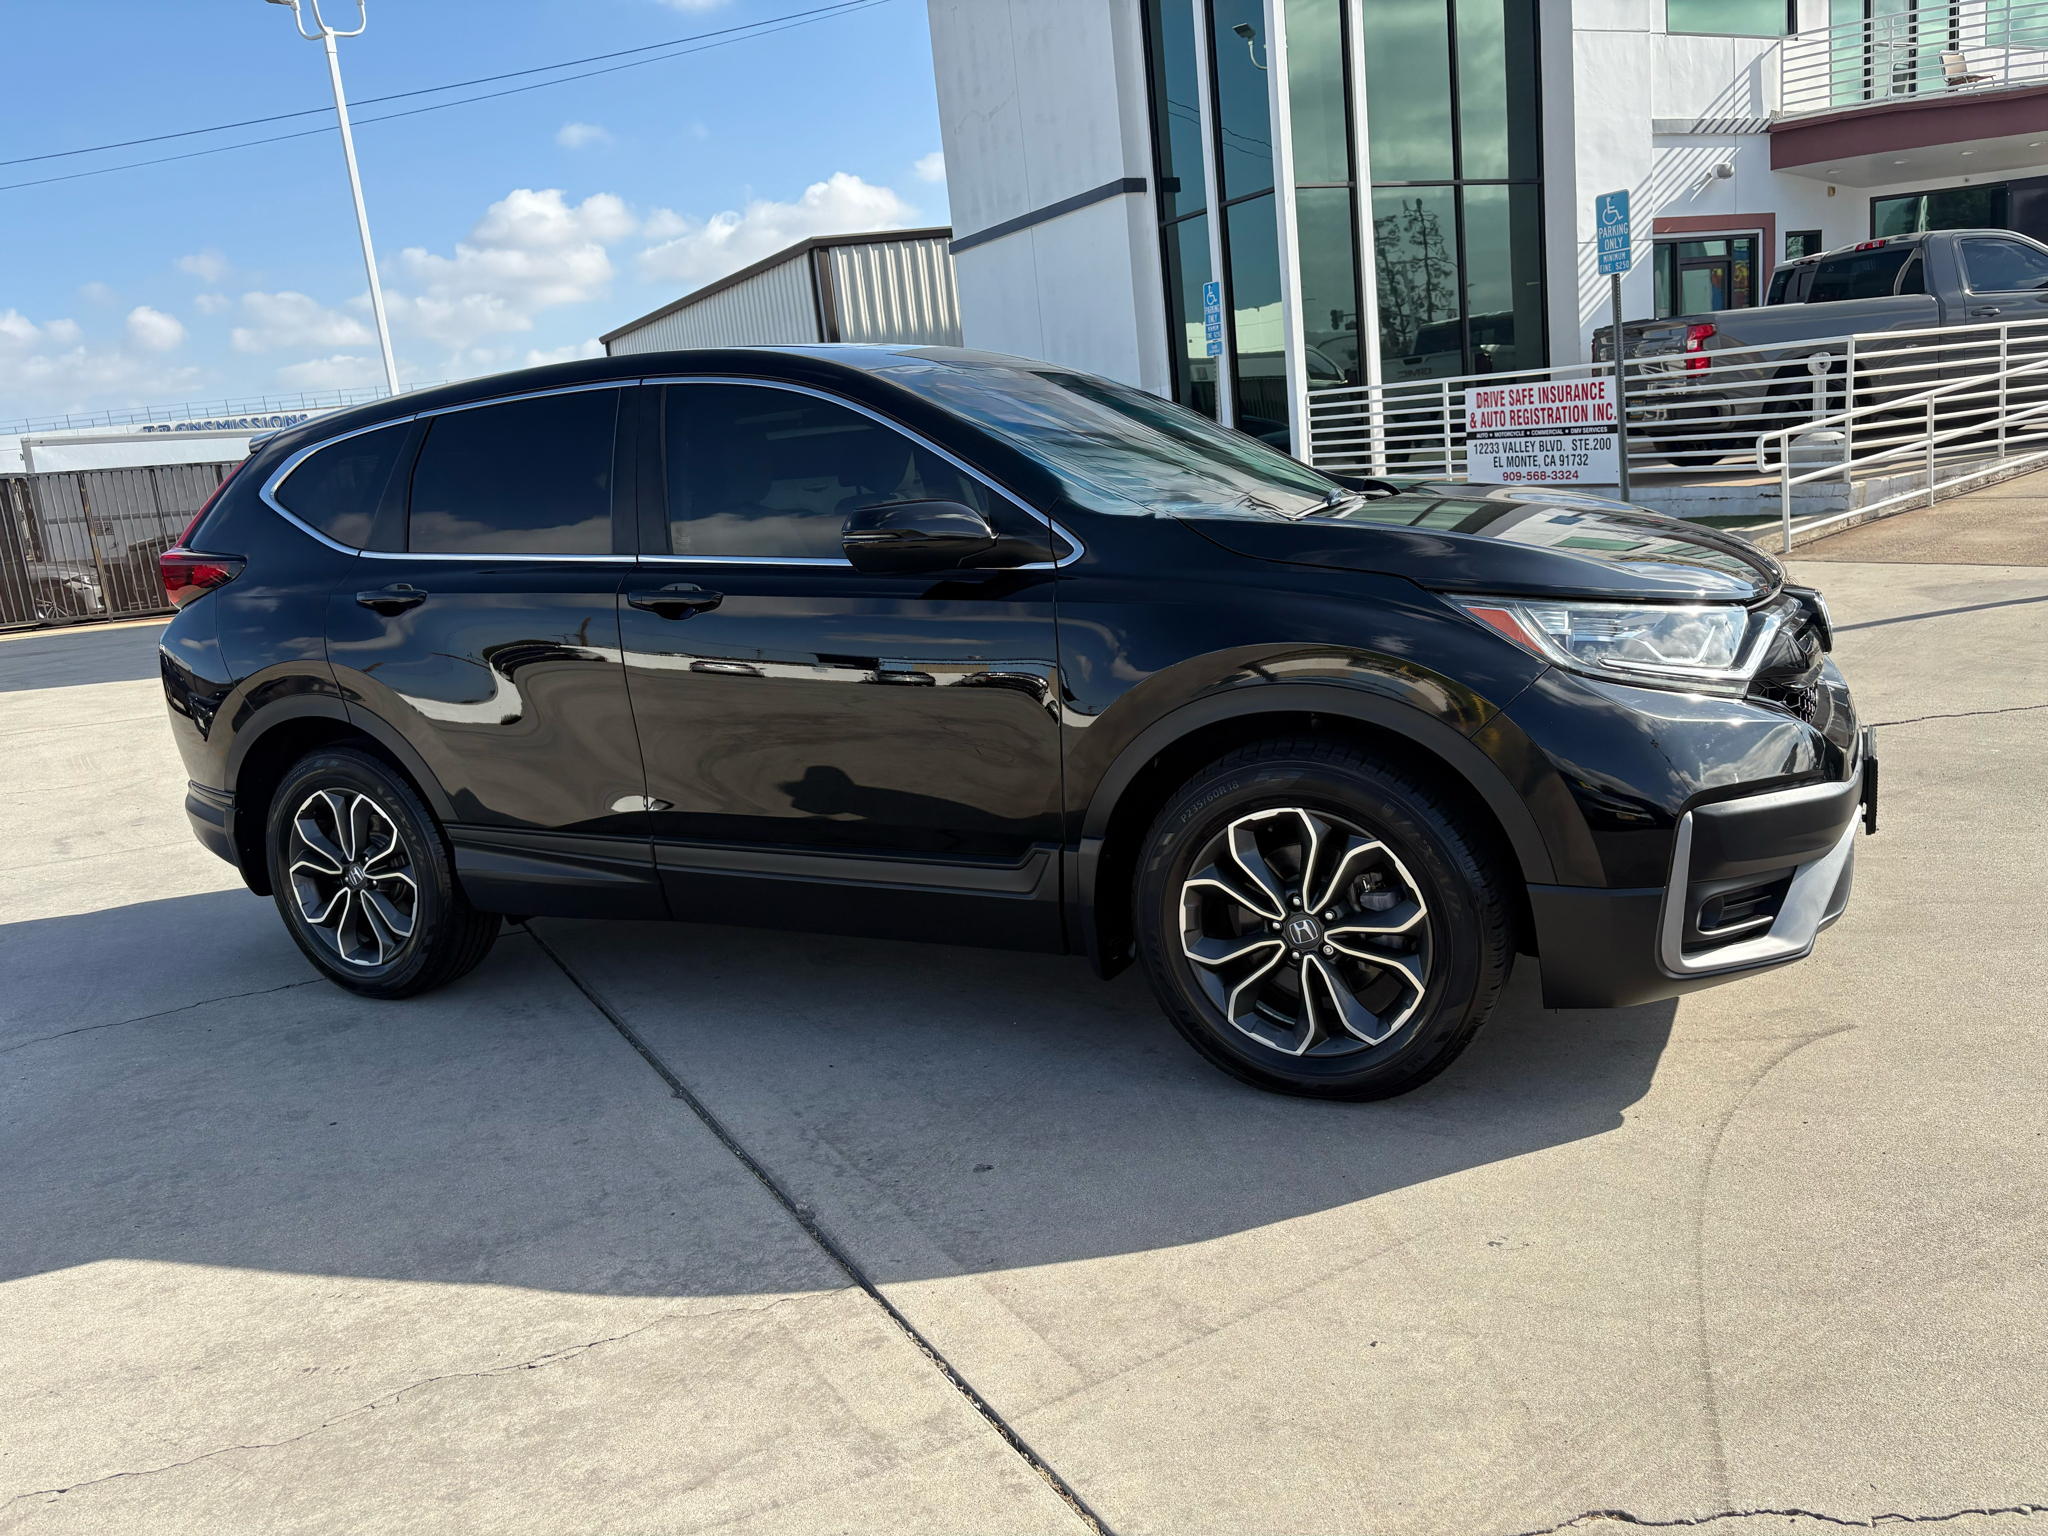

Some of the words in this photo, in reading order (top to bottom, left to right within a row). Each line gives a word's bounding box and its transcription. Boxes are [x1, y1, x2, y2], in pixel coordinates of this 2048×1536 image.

[1599, 223, 1628, 239] PARKING
[1604, 237, 1623, 251] ONLY
[1603, 251, 1626, 263] MINIMUM
[1600, 263, 1612, 273] FINE
[1615, 260, 1630, 270] $250
[1476, 390, 1506, 409] DRIVE
[1508, 387, 1534, 406] SAFE
[1538, 381, 1605, 404] INSURANCE
[1469, 412, 1477, 429] &
[1480, 409, 1506, 428] AUTO
[1509, 404, 1589, 427] REGISTRATION
[1592, 402, 1617, 422] INC.
[1494, 430, 1525, 438] MOTORCYCLE
[1531, 428, 1564, 436] COMMERCIAL
[1582, 426, 1608, 434] SERVICES
[1473, 442, 1500, 455] 12233
[1501, 440, 1536, 454] VALLEY
[1539, 439, 1566, 453] BLVD.
[1493, 456, 1503, 468] EL
[1506, 454, 1541, 469] MONTE,
[1543, 454, 1556, 467] CA
[1559, 453, 1589, 467] 91732
[1502, 470, 1579, 482] 909-568-3324
